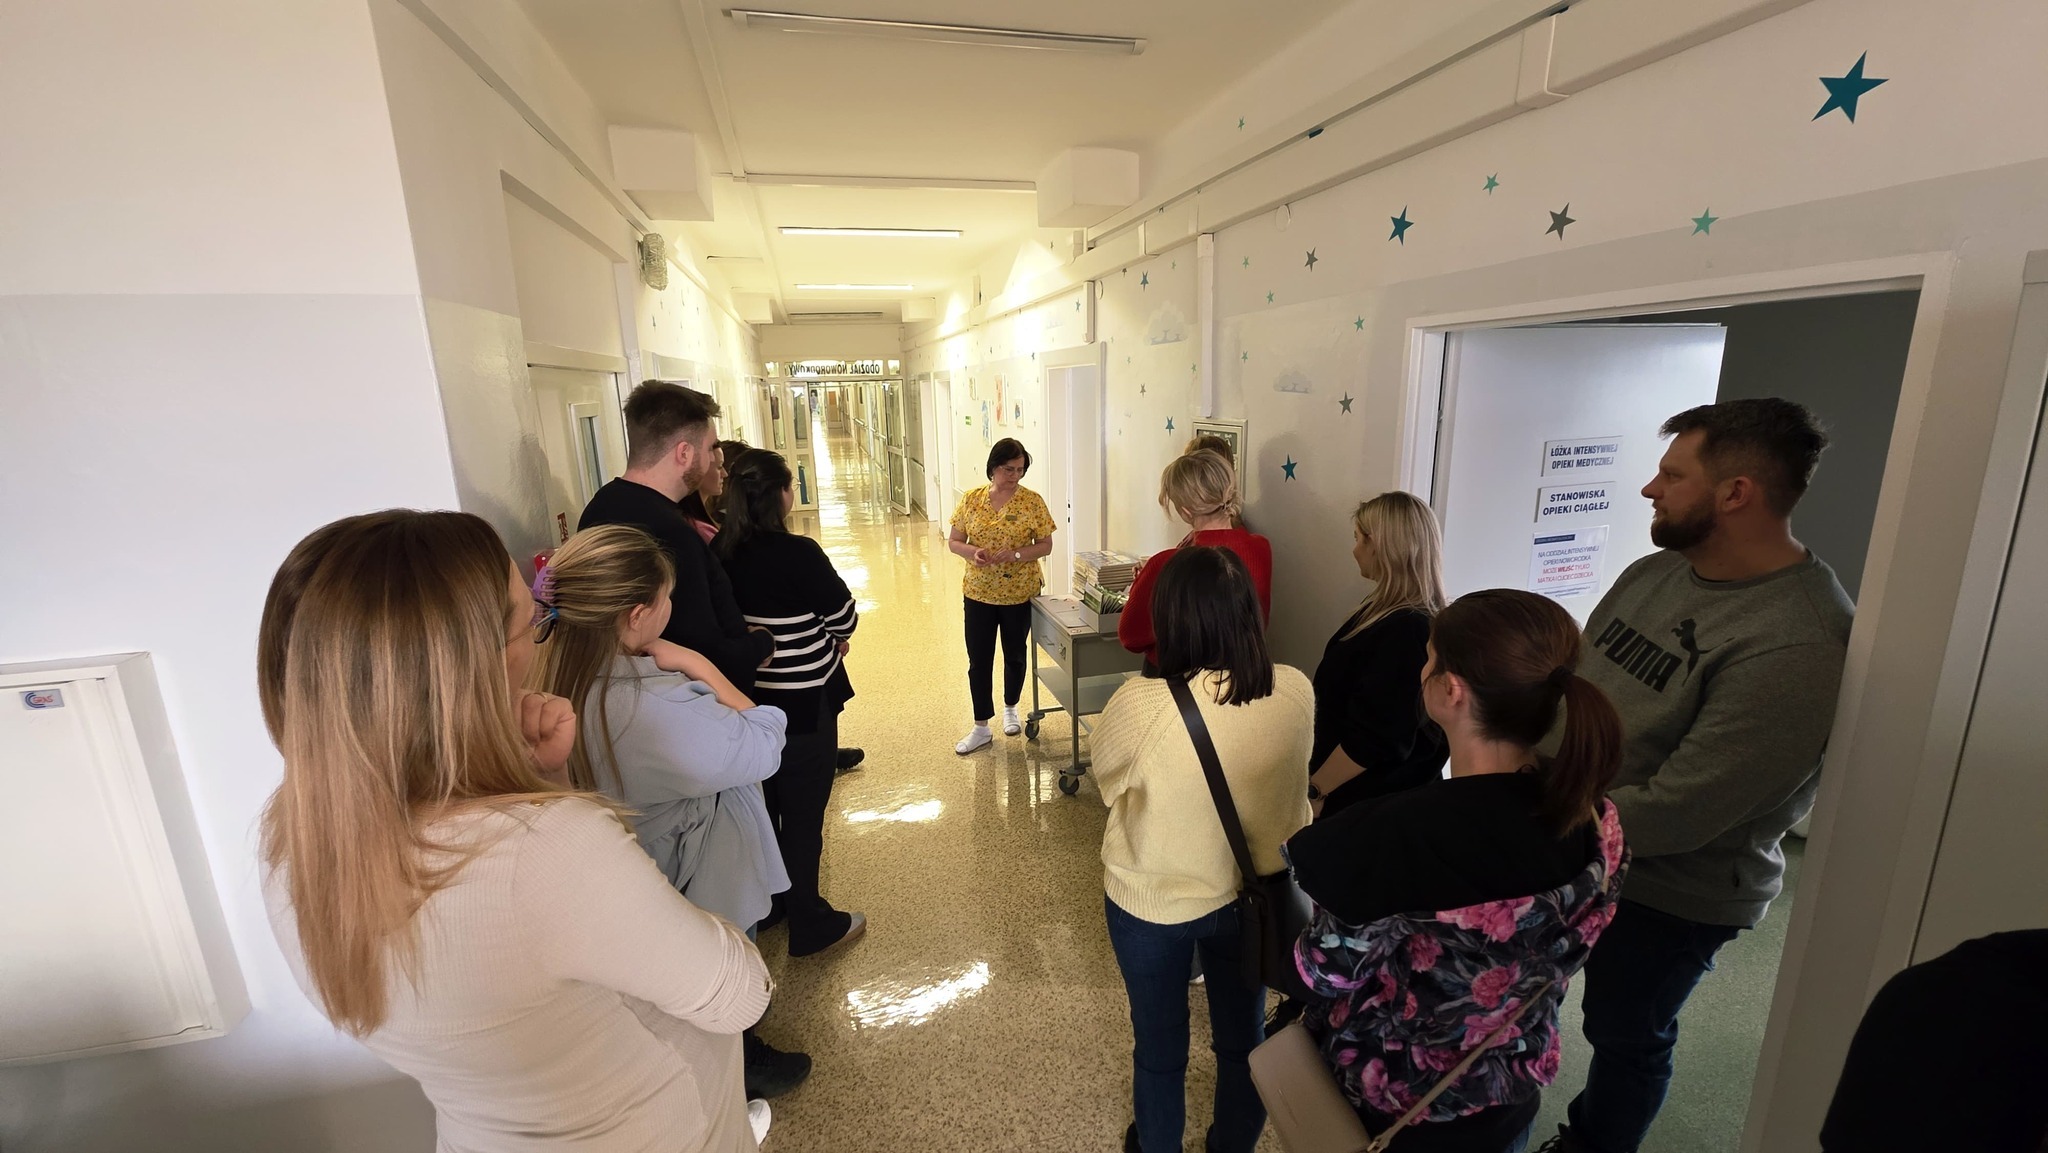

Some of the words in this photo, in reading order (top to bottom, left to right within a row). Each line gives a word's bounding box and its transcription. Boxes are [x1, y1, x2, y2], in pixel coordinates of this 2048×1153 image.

[1550, 445, 1572, 457] ŁÓŻKA
[1573, 443, 1619, 456] INTENSYWNEJ
[1551, 459, 1575, 470] OPIEKI
[1575, 456, 1615, 468] MEDYCZNEJ
[1549, 489, 1606, 503] STANOWISKA
[1542, 504, 1572, 516] OPIEKI
[1573, 501, 1610, 514] CIĄGŁEJ
[1593, 617, 1683, 693] PUMA
